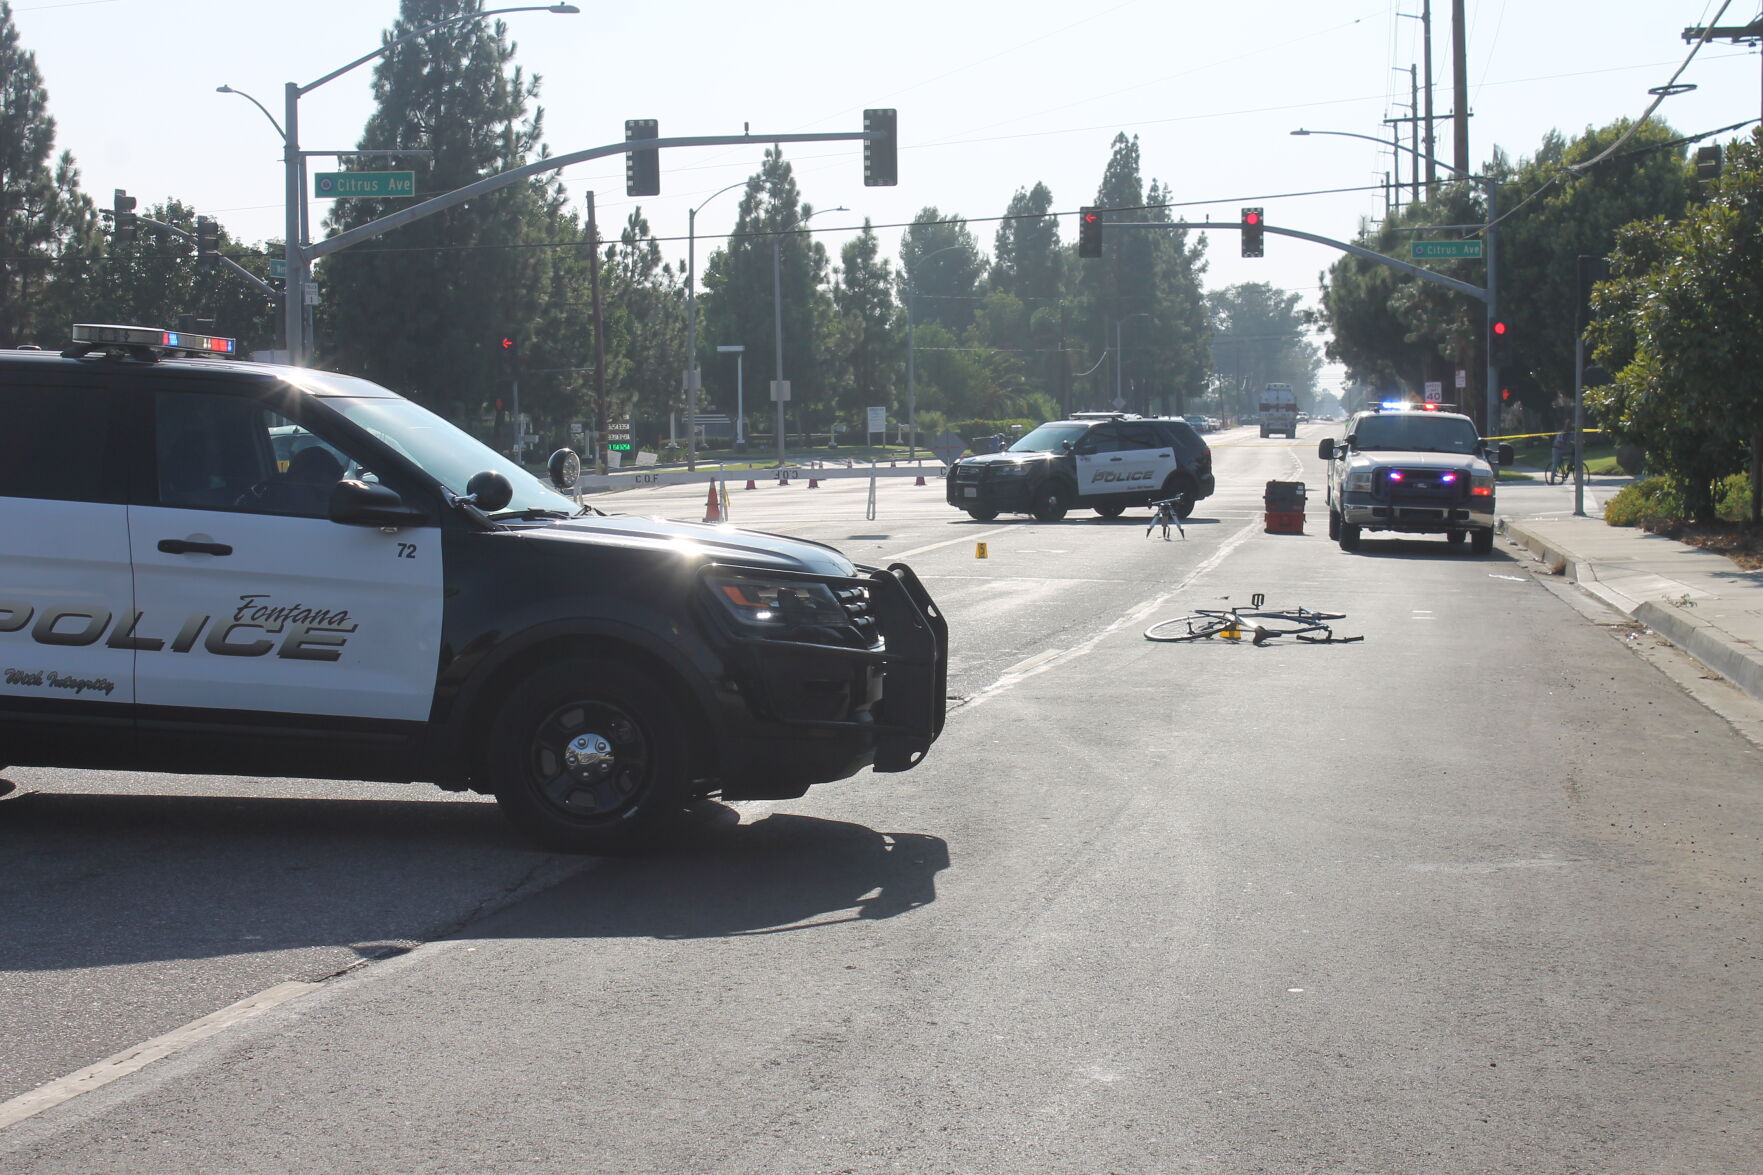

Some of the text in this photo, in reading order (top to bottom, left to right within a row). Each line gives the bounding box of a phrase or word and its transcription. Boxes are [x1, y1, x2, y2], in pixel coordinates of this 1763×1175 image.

[337, 178, 411, 191] Citrus Ave
[1427, 245, 1480, 255] Citrus Ave
[1427, 392, 1441, 400] 40
[1091, 470, 1154, 484] POLICE
[397, 542, 417, 559] 72
[233, 594, 353, 627] Fontana
[4, 667, 115, 696] With Integrity
